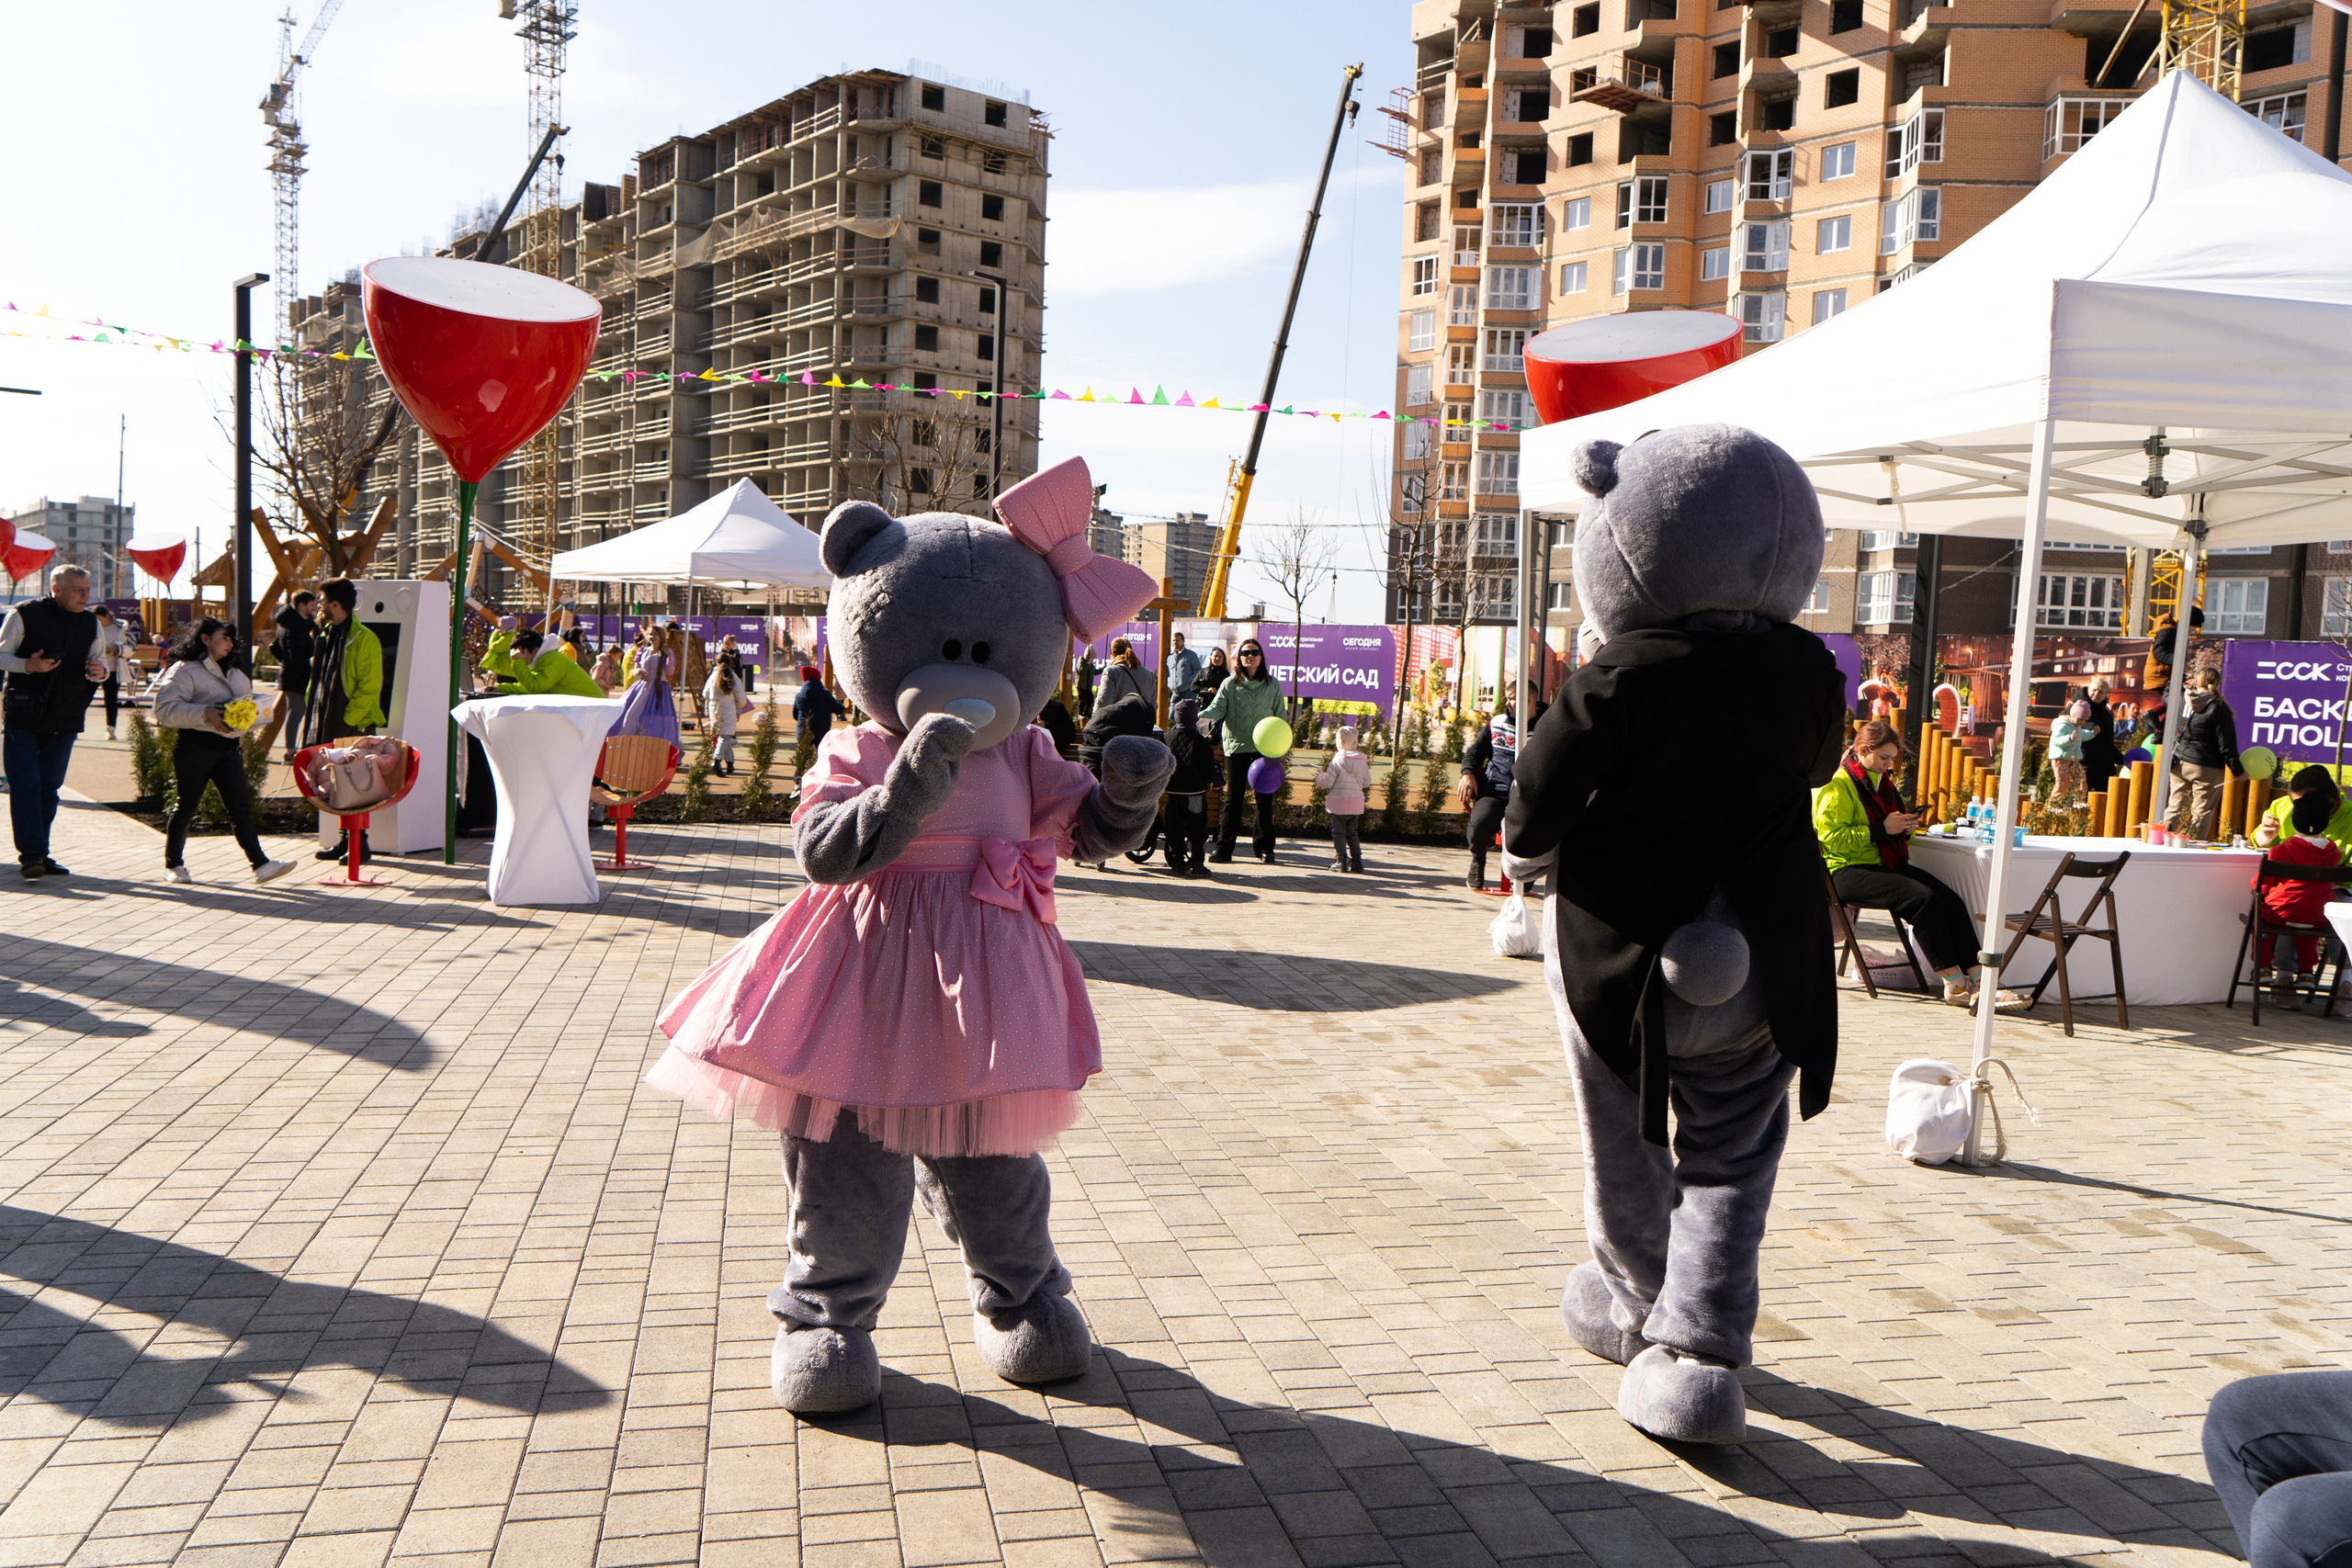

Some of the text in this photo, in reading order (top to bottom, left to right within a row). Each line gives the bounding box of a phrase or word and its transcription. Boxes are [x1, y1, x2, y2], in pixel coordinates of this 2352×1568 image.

[1342, 637, 1382, 647] СЕГОДНЯ
[1342, 668, 1379, 690] САД
[2255, 696, 2352, 721] БАСК
